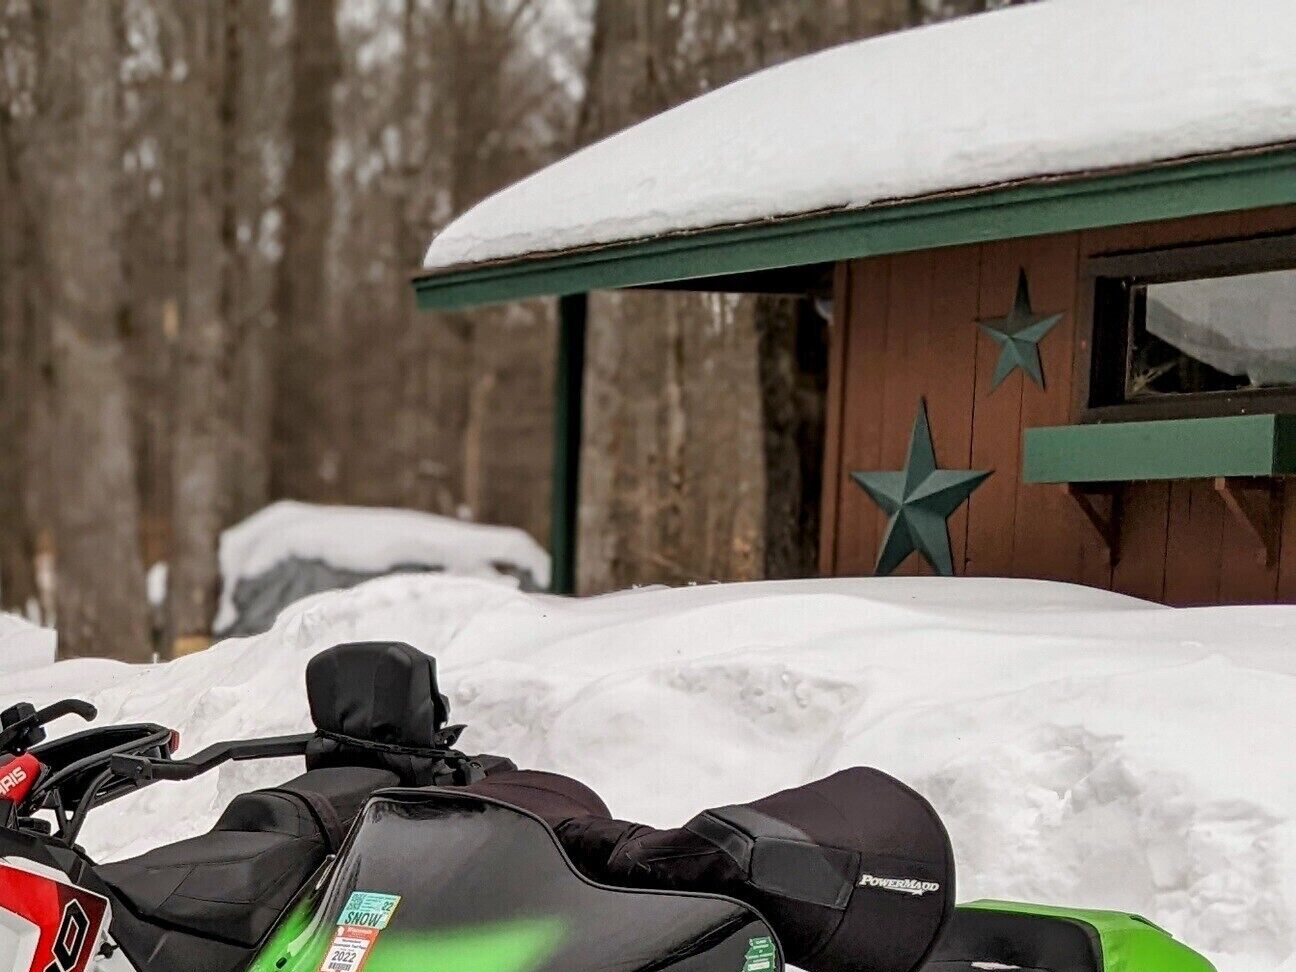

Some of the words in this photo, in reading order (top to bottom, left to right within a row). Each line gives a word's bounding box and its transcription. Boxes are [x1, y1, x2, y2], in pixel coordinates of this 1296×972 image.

[381, 901, 394, 912] 22
[344, 911, 383, 928] SNOW
[331, 951, 357, 964] 2022
